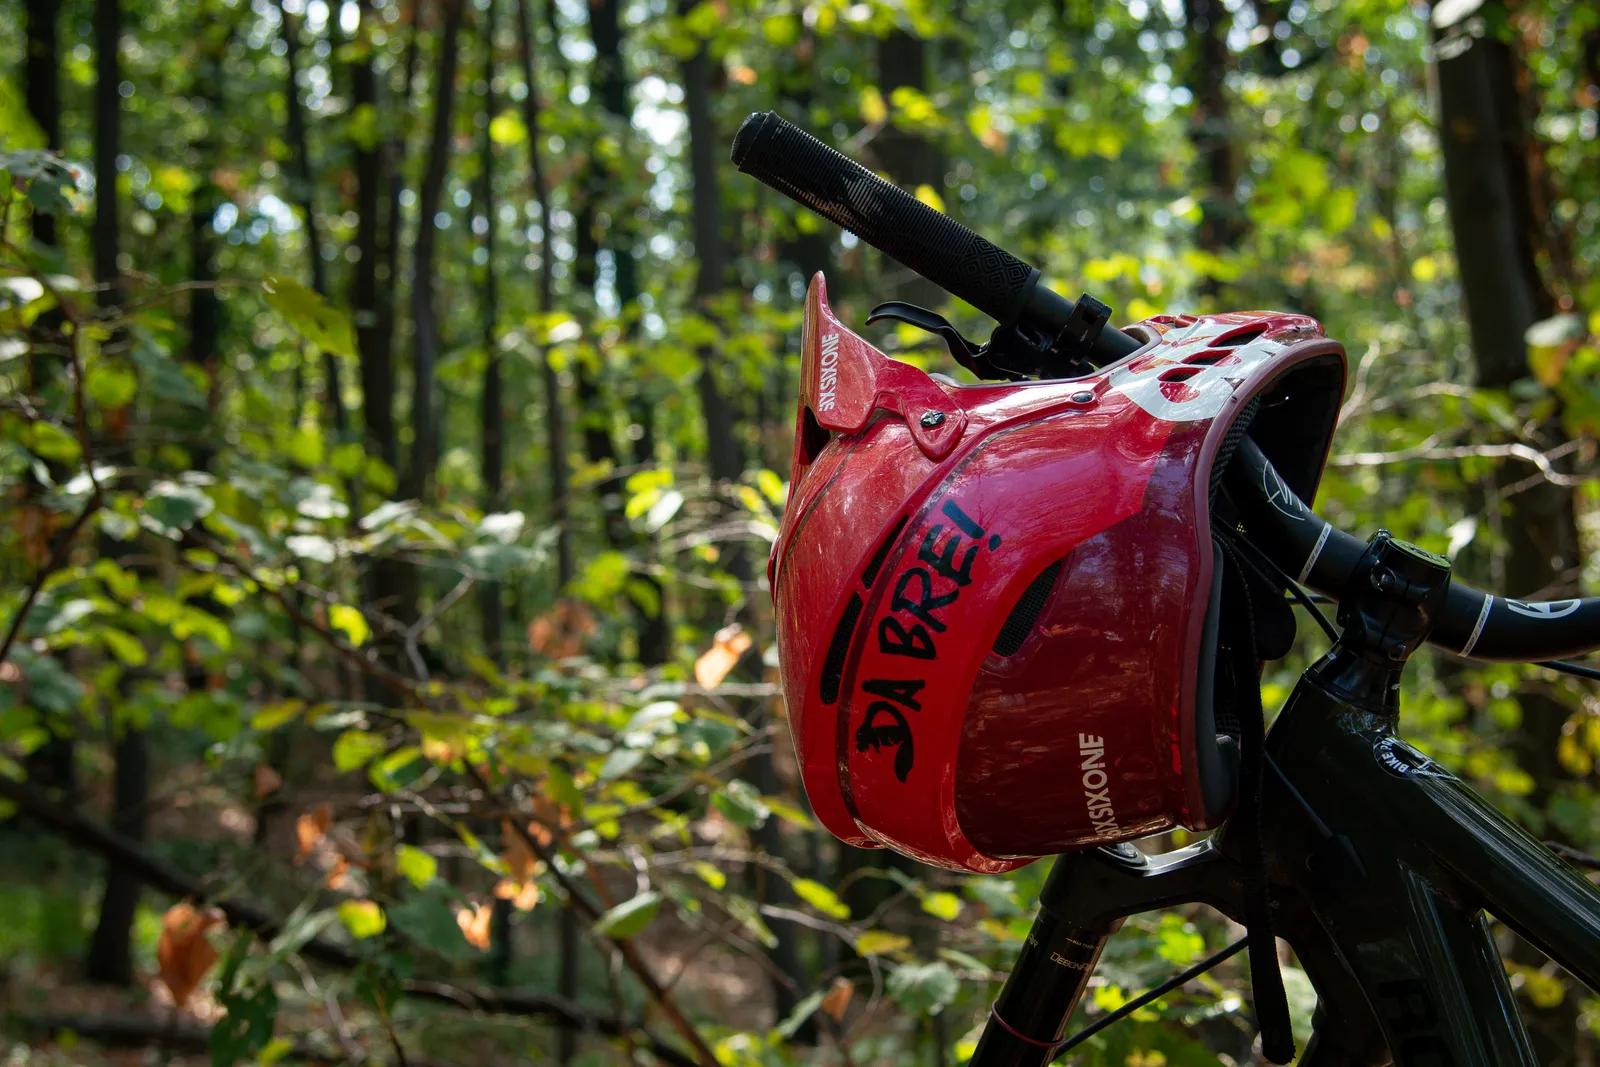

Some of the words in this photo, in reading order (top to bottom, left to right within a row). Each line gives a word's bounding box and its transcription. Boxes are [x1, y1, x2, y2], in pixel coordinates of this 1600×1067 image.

[877, 499, 1002, 661] BRE!
[855, 678, 926, 784] DA
[1381, 752, 1410, 773] BIKE
